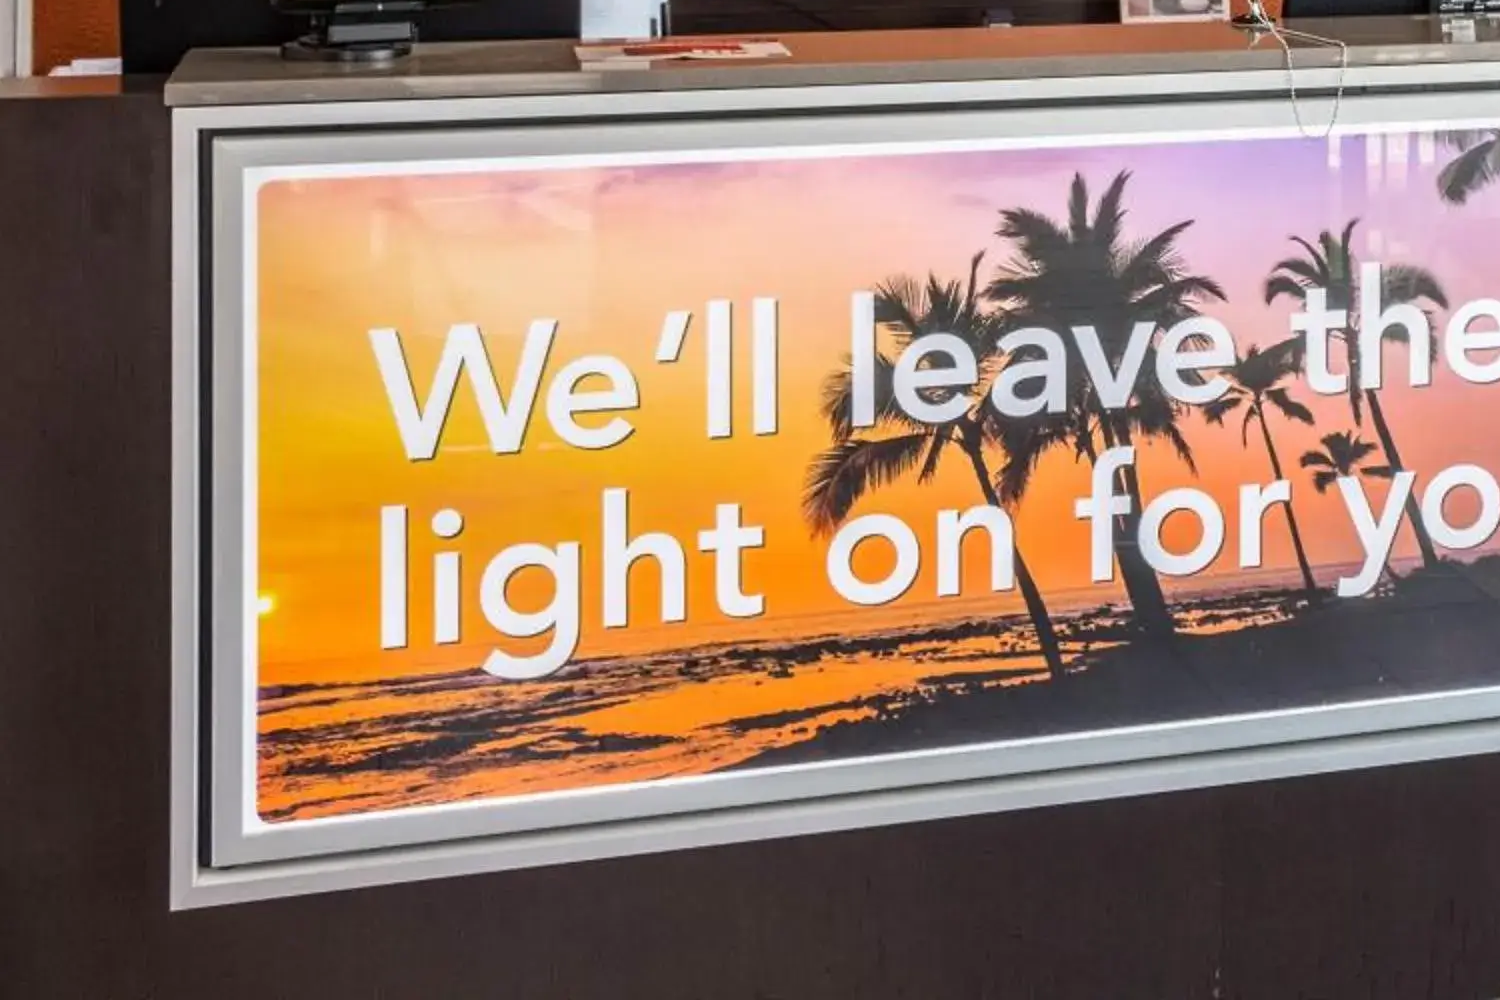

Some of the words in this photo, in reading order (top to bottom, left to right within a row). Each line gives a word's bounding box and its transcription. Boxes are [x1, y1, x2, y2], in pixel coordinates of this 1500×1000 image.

[368, 296, 778, 462] We'll
[851, 290, 1238, 428] leave
[379, 487, 767, 681] light
[826, 502, 1016, 606] on
[1075, 445, 1291, 584] for
